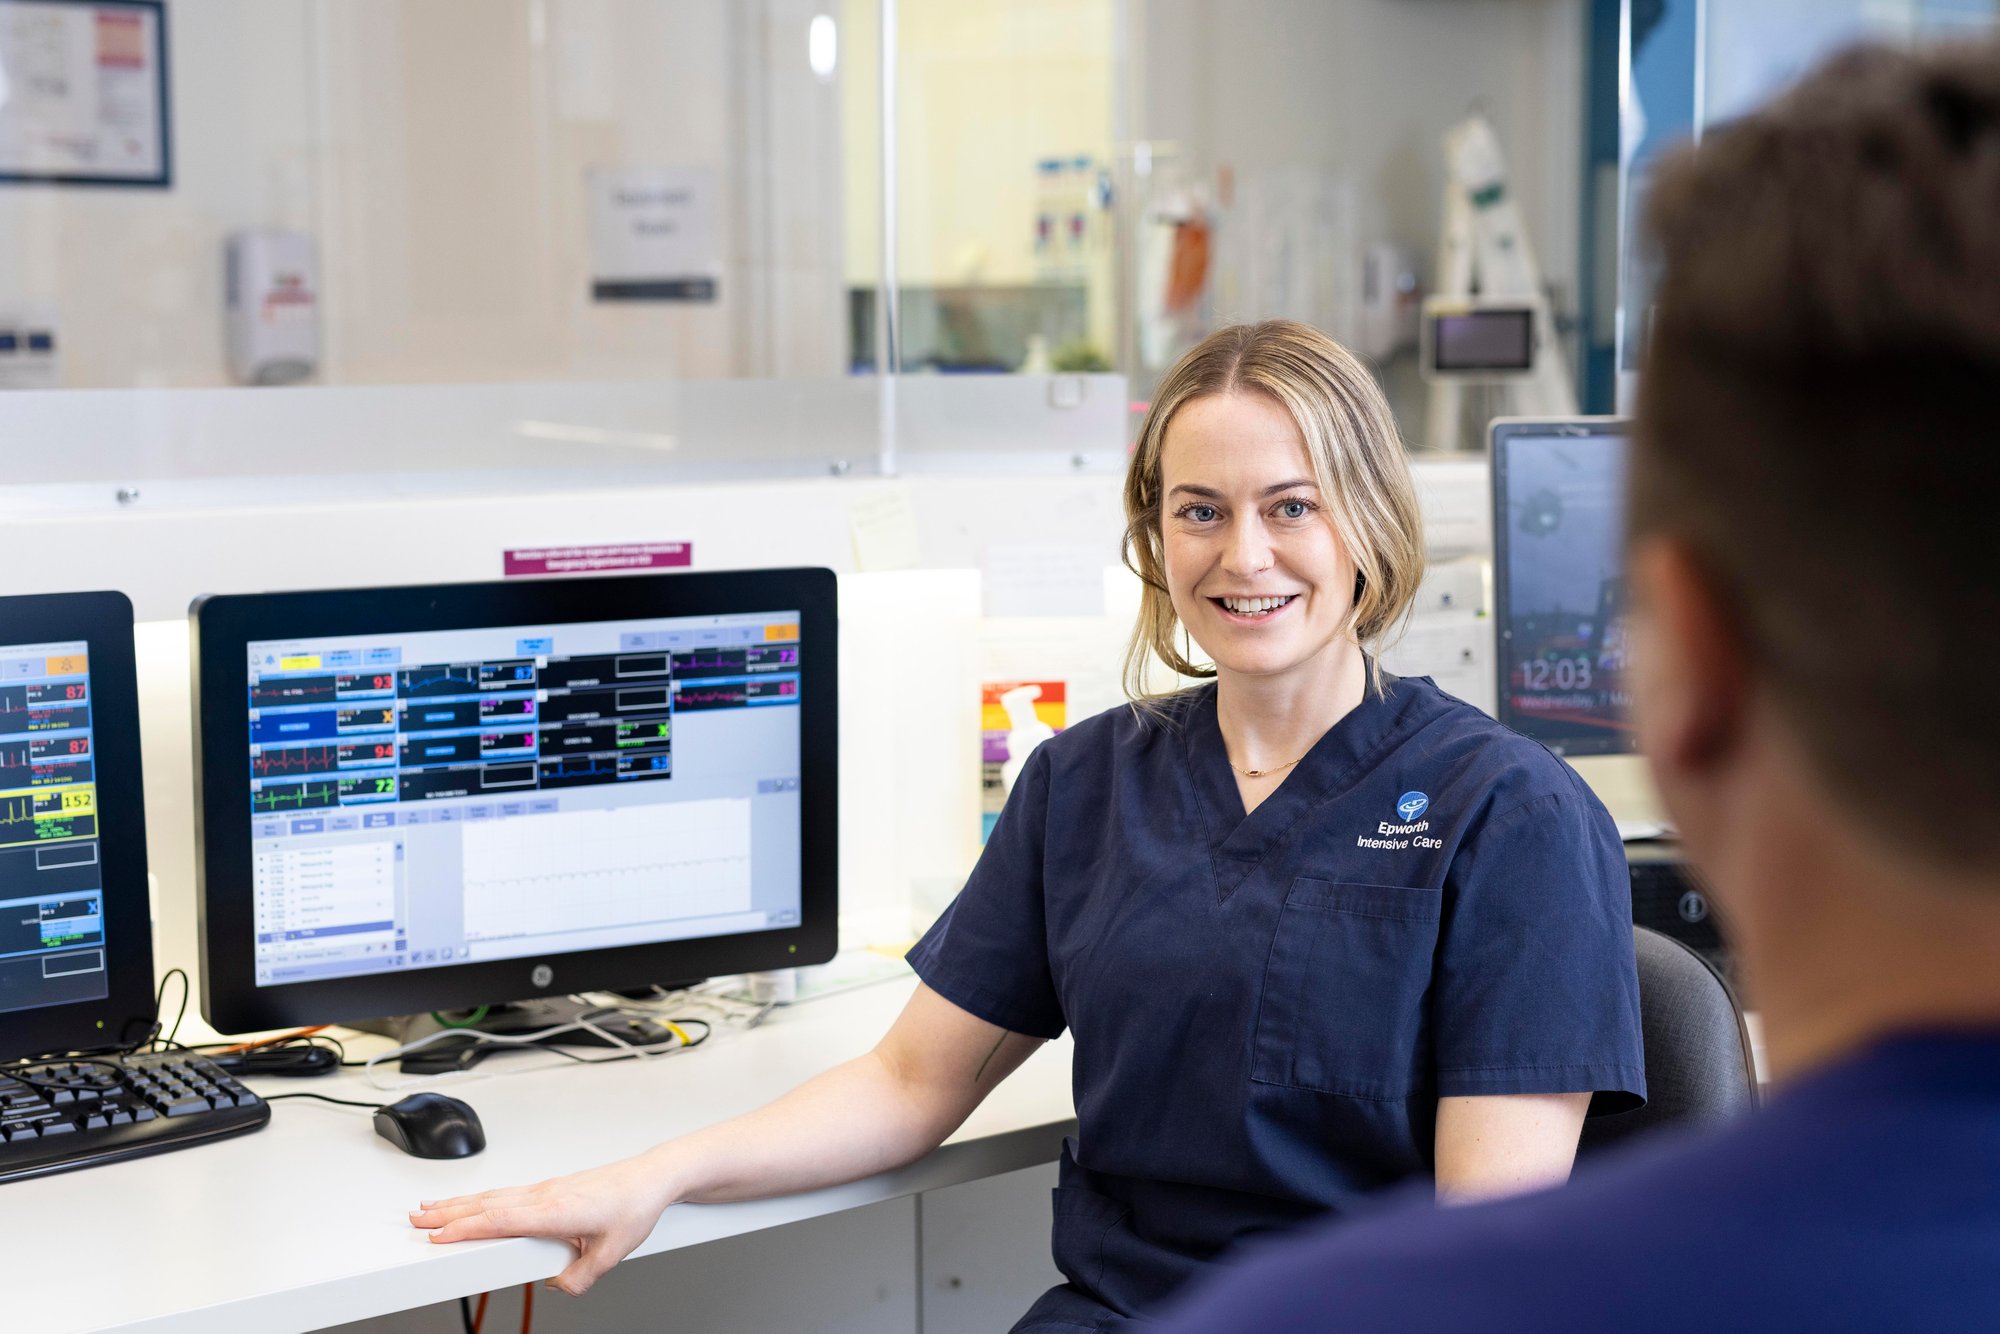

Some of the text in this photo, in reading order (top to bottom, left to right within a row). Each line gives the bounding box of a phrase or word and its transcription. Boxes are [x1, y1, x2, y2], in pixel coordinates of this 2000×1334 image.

[1520, 657, 1592, 690] 12:03
[373, 675, 392, 689] 93
[66, 685, 86, 699] 87
[383, 710, 393, 723] X
[69, 740, 89, 753] 87
[374, 744, 393, 758] 94
[375, 778, 394, 792] 72
[65, 795, 92, 808] 152
[1377, 820, 1429, 837] Epworth
[1357, 835, 1443, 850] Intensive Care
[88, 900, 98, 914] X
